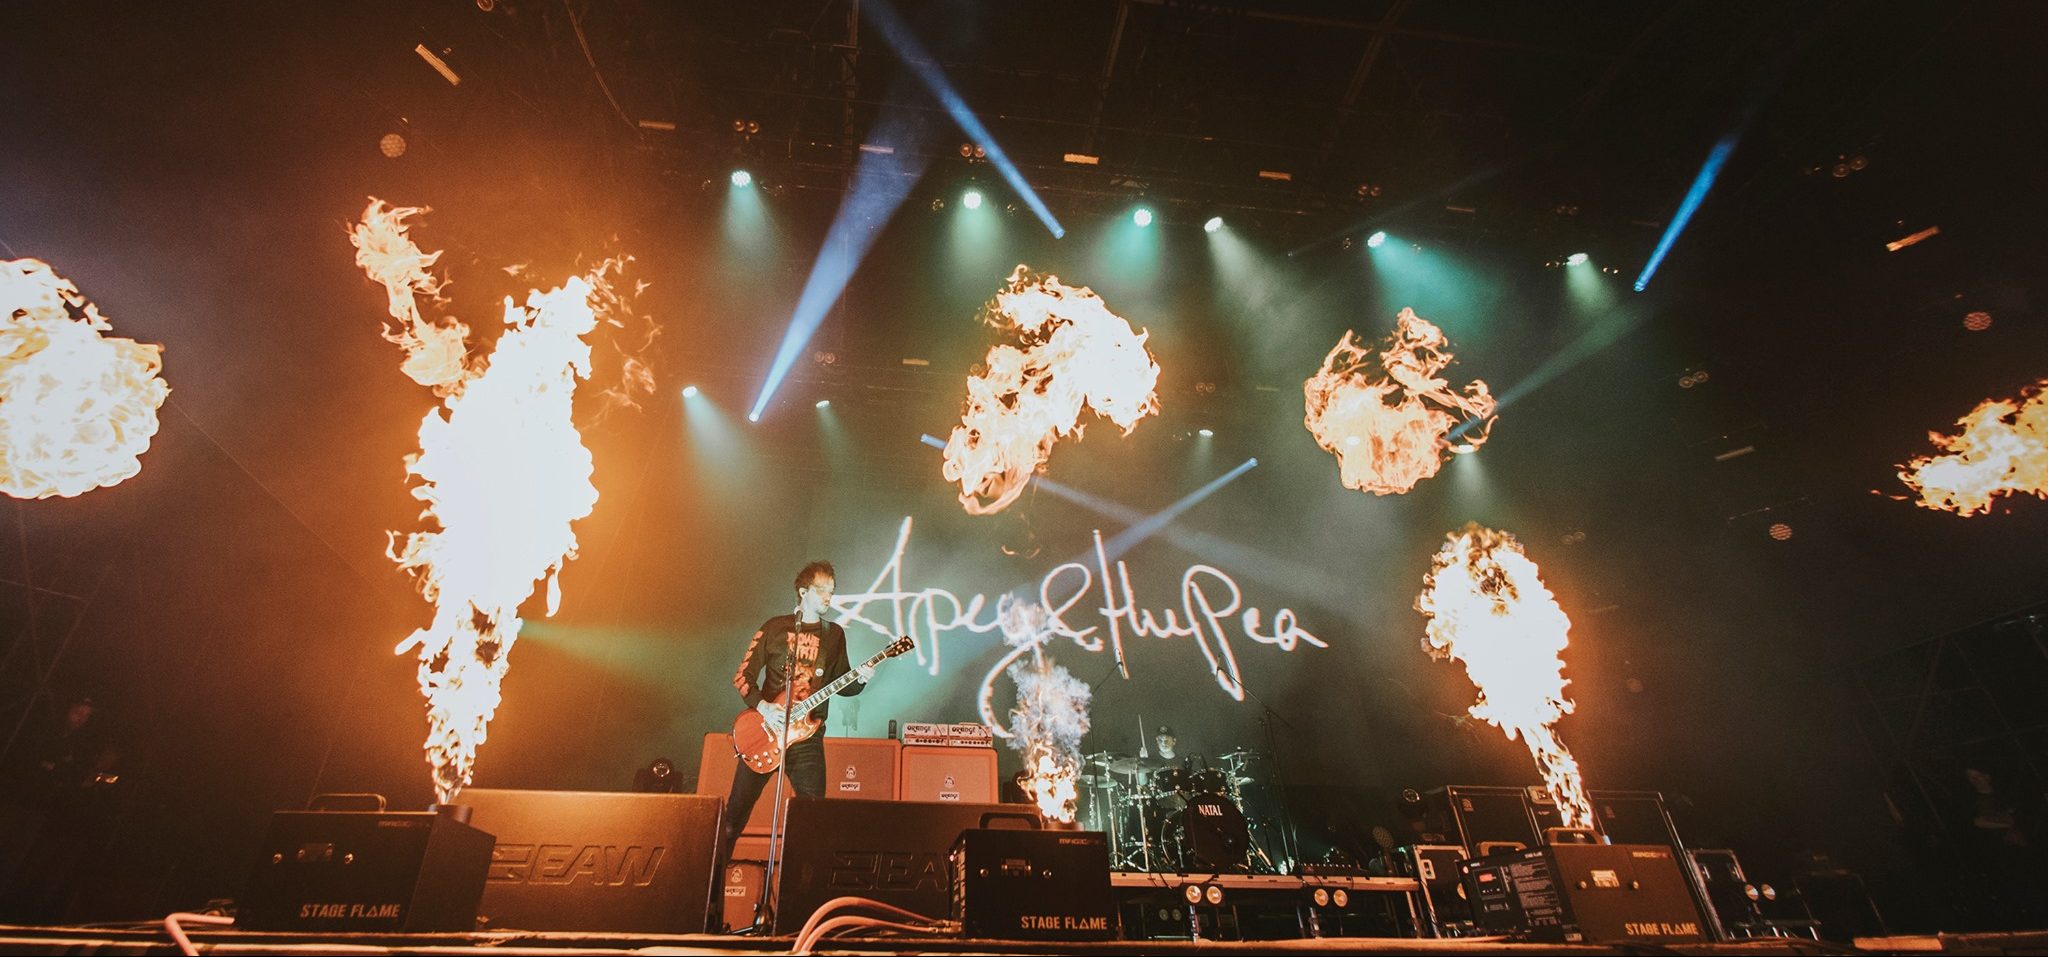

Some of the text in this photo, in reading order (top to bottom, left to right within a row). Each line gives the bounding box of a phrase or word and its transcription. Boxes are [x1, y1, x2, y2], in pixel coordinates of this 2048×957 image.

[1198, 804, 1223, 817] NATAL
[300, 903, 401, 918] STAGE FLAME
[1021, 915, 1108, 931] STAGE FLAME
[1625, 922, 1699, 936] STAGE FLAME
